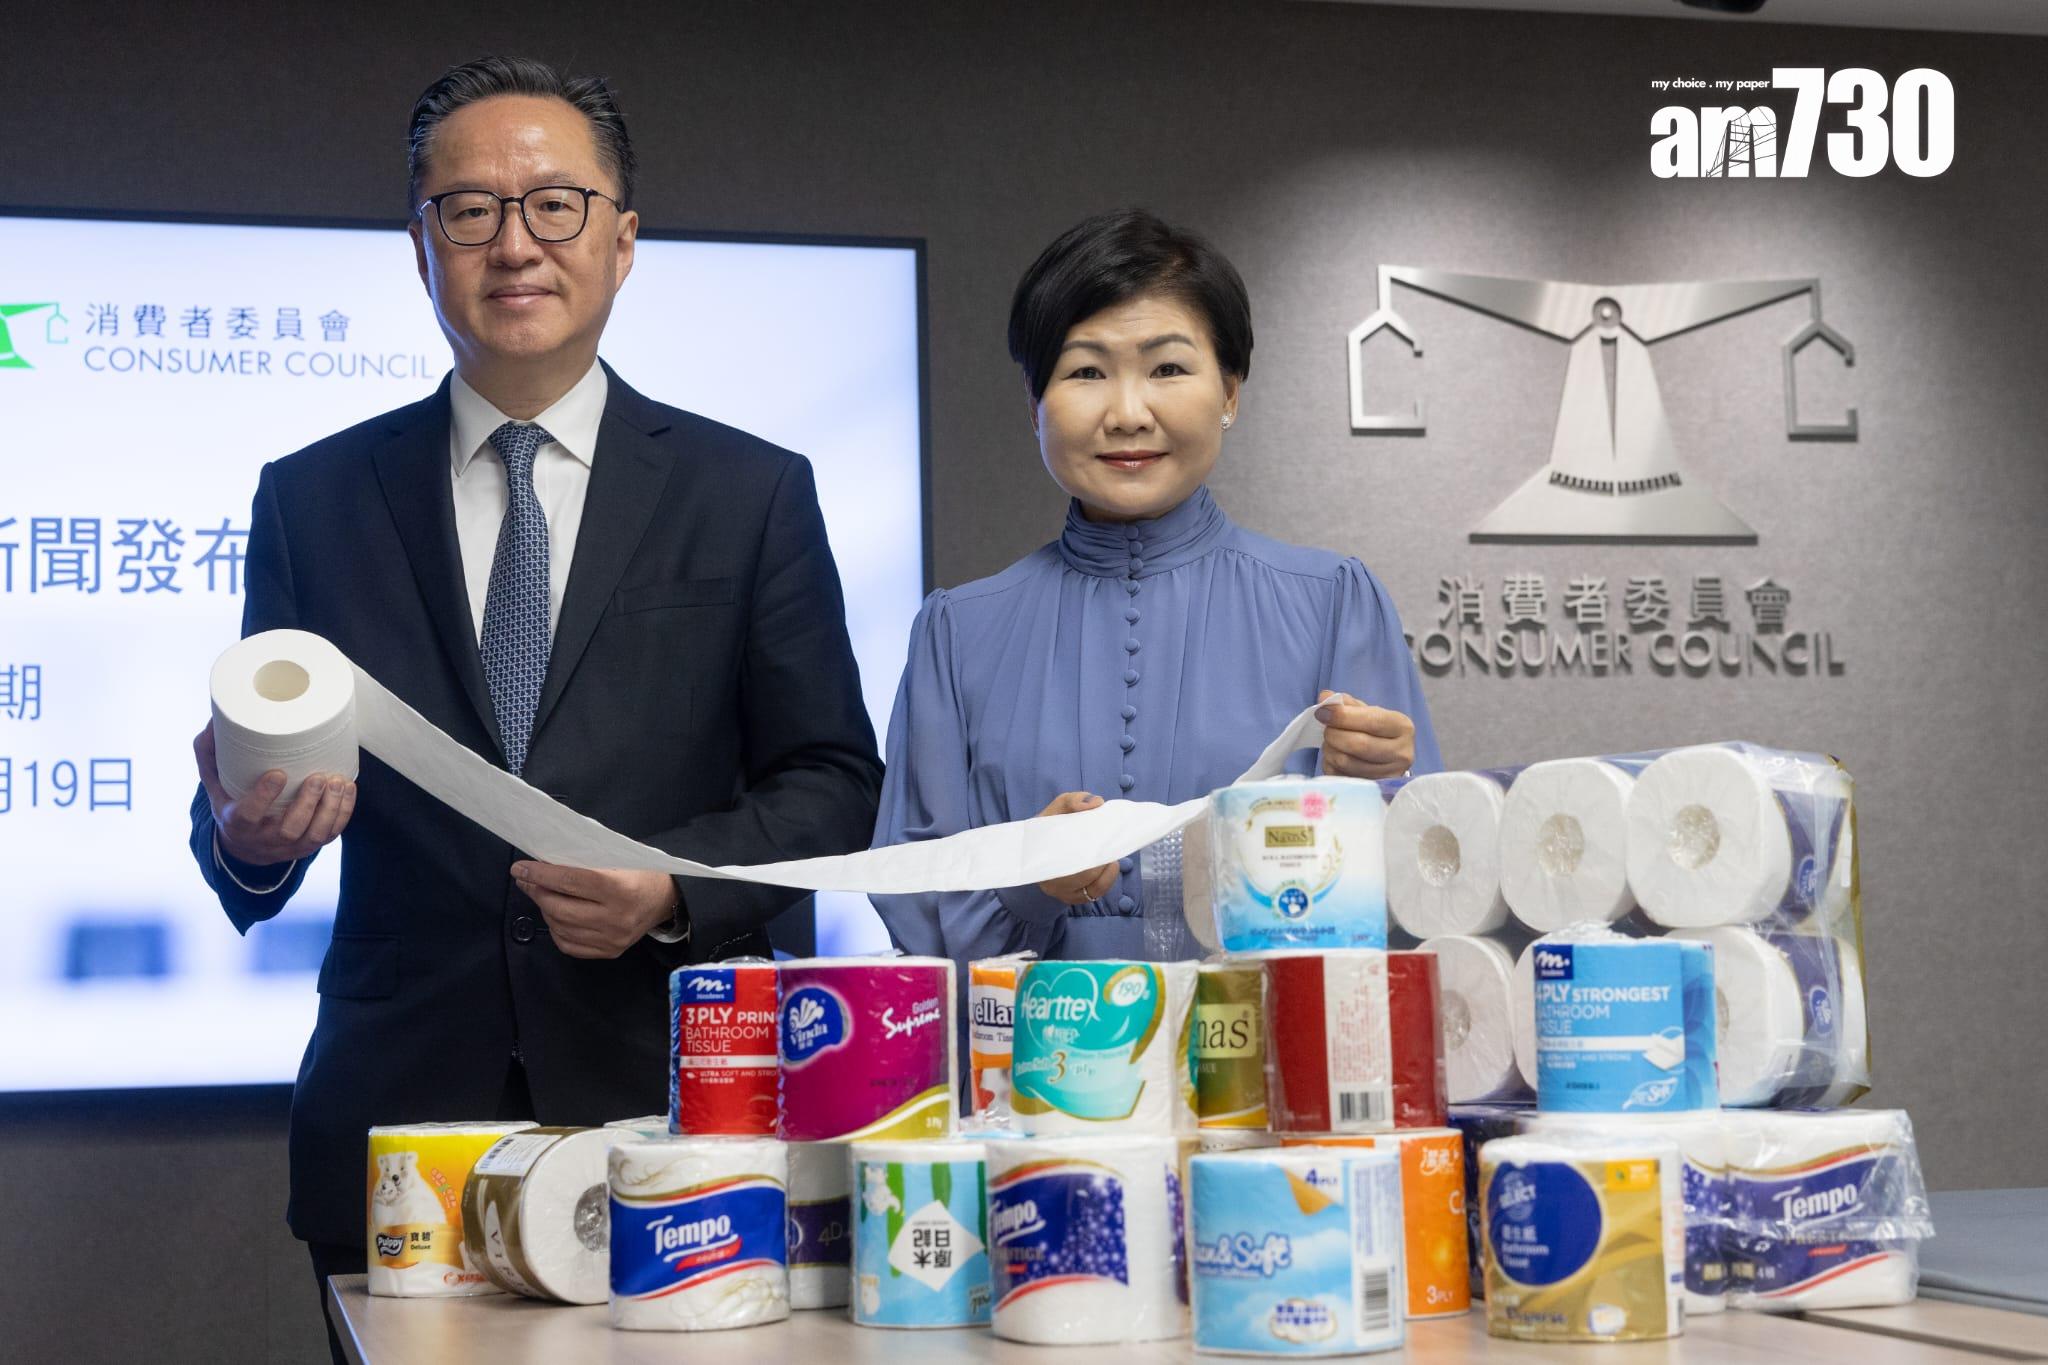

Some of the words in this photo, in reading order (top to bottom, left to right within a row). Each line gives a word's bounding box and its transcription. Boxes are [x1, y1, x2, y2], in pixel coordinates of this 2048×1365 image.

[85, 302, 351, 342] 消費者委員會
[84, 346, 272, 376] CONSUMER
[285, 350, 435, 379] COUNCIL
[0, 516, 248, 595] 聞發布
[1439, 573, 1792, 632] 消費者委員會
[1649, 631, 1845, 677] COUNCIL
[1020, 990, 1101, 1025] Hearttex
[1572, 985, 1671, 1003] STRONGEST
[685, 1026, 769, 1041] BATHROOM
[881, 1007, 941, 1041] Supreme
[685, 1040, 732, 1054] TISSUE
[1047, 1051, 1067, 1083] 3
[1772, 1183, 1858, 1224] Tempo
[646, 1214, 731, 1255] Tempo
